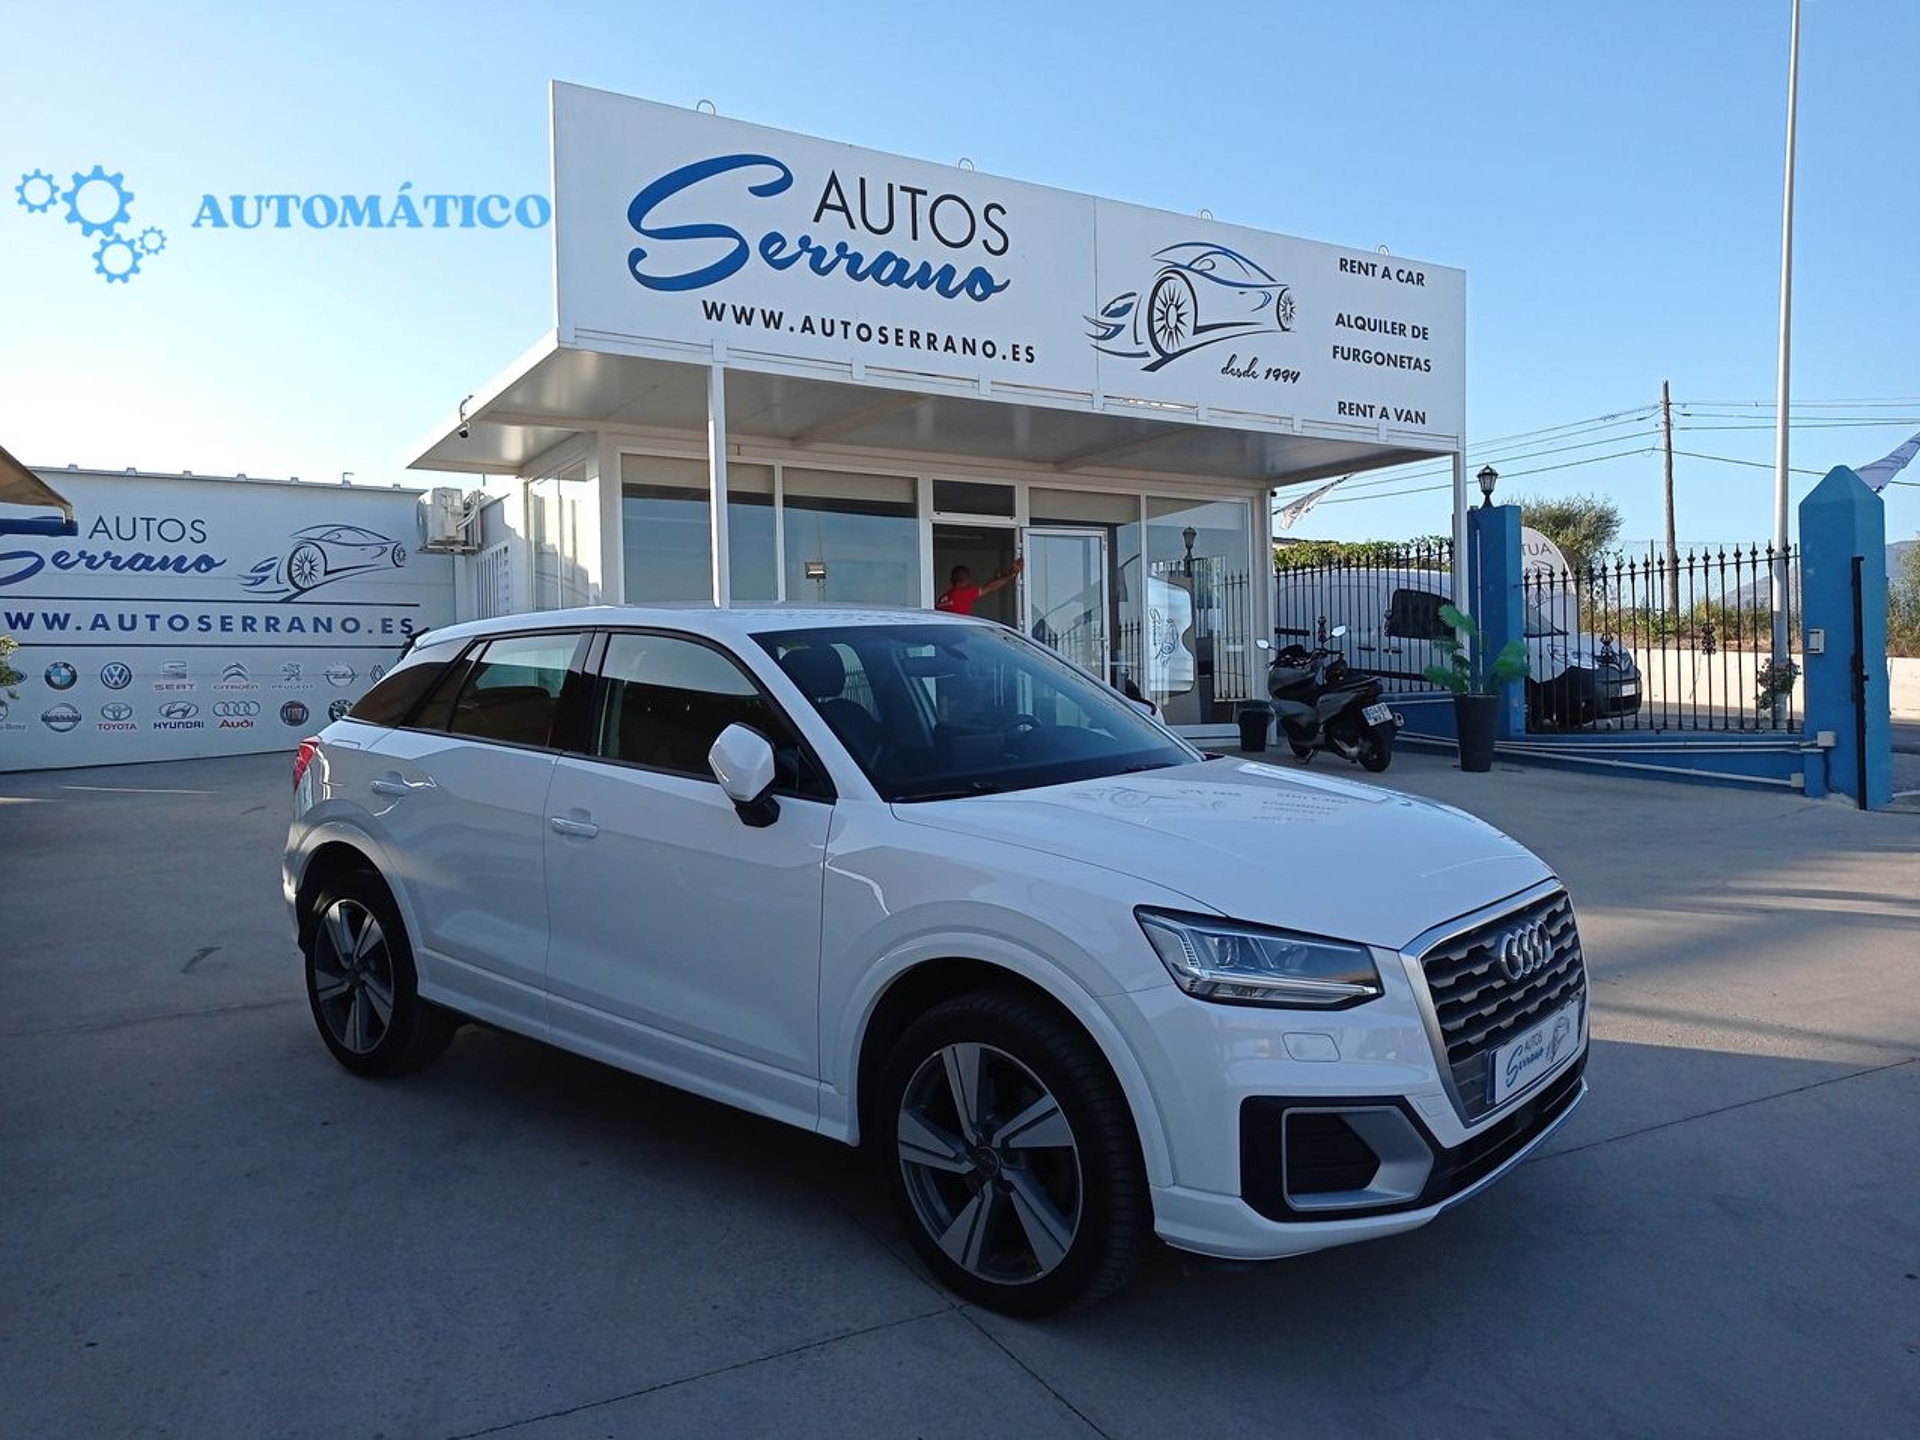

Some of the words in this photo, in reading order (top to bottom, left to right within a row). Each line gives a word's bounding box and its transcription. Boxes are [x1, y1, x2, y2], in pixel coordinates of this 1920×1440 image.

[812, 170, 1009, 256] AUTOS
[627, 153, 1010, 302] Serrano
[1339, 258, 1378, 278] RENT
[1381, 266, 1392, 281] A
[1396, 268, 1425, 287] CAR
[702, 300, 1035, 364] WWW.AUTOSERRANO.ES
[1335, 313, 1406, 338] ALQUILER
[1411, 322, 1429, 341] DE
[1221, 354, 1259, 379] desde
[1264, 366, 1300, 383] 1994
[1333, 345, 1431, 373] FURGONETAS
[1338, 401, 1376, 421] RENT
[1379, 407, 1390, 421] A
[1394, 408, 1426, 425] VAN
[88, 515, 207, 544] AUTOS
[154, 684, 196, 692] SEAT
[98, 723, 137, 731] TOYOTA
[153, 720, 204, 729] HYUNDAI
[218, 719, 254, 729] Audi
